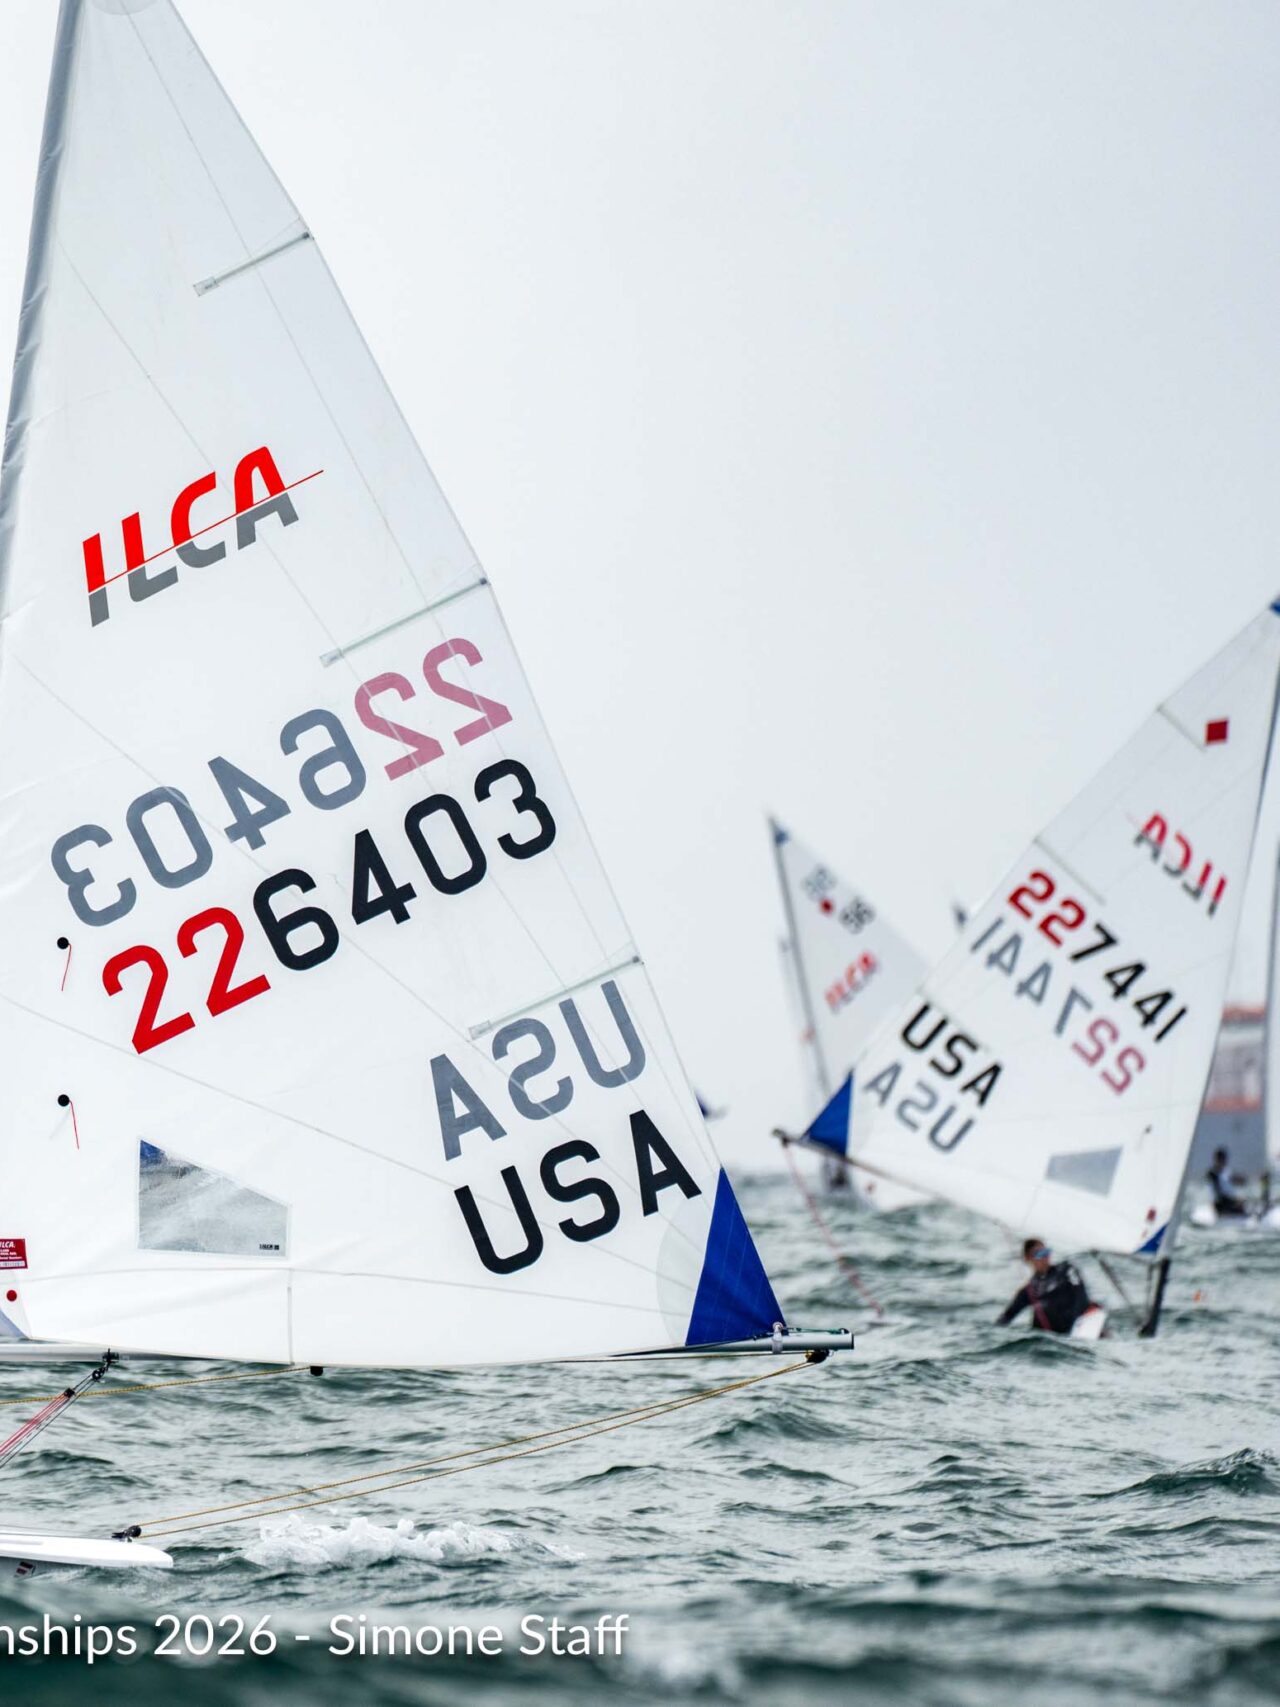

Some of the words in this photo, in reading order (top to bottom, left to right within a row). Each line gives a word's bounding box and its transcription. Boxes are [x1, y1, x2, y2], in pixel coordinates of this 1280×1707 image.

[81, 444, 301, 628] ILCA
[101, 758, 557, 1054] 226403
[1006, 868, 1189, 1044] 227441
[900, 1002, 1005, 1109] USA
[453, 1109, 702, 1275] USA
